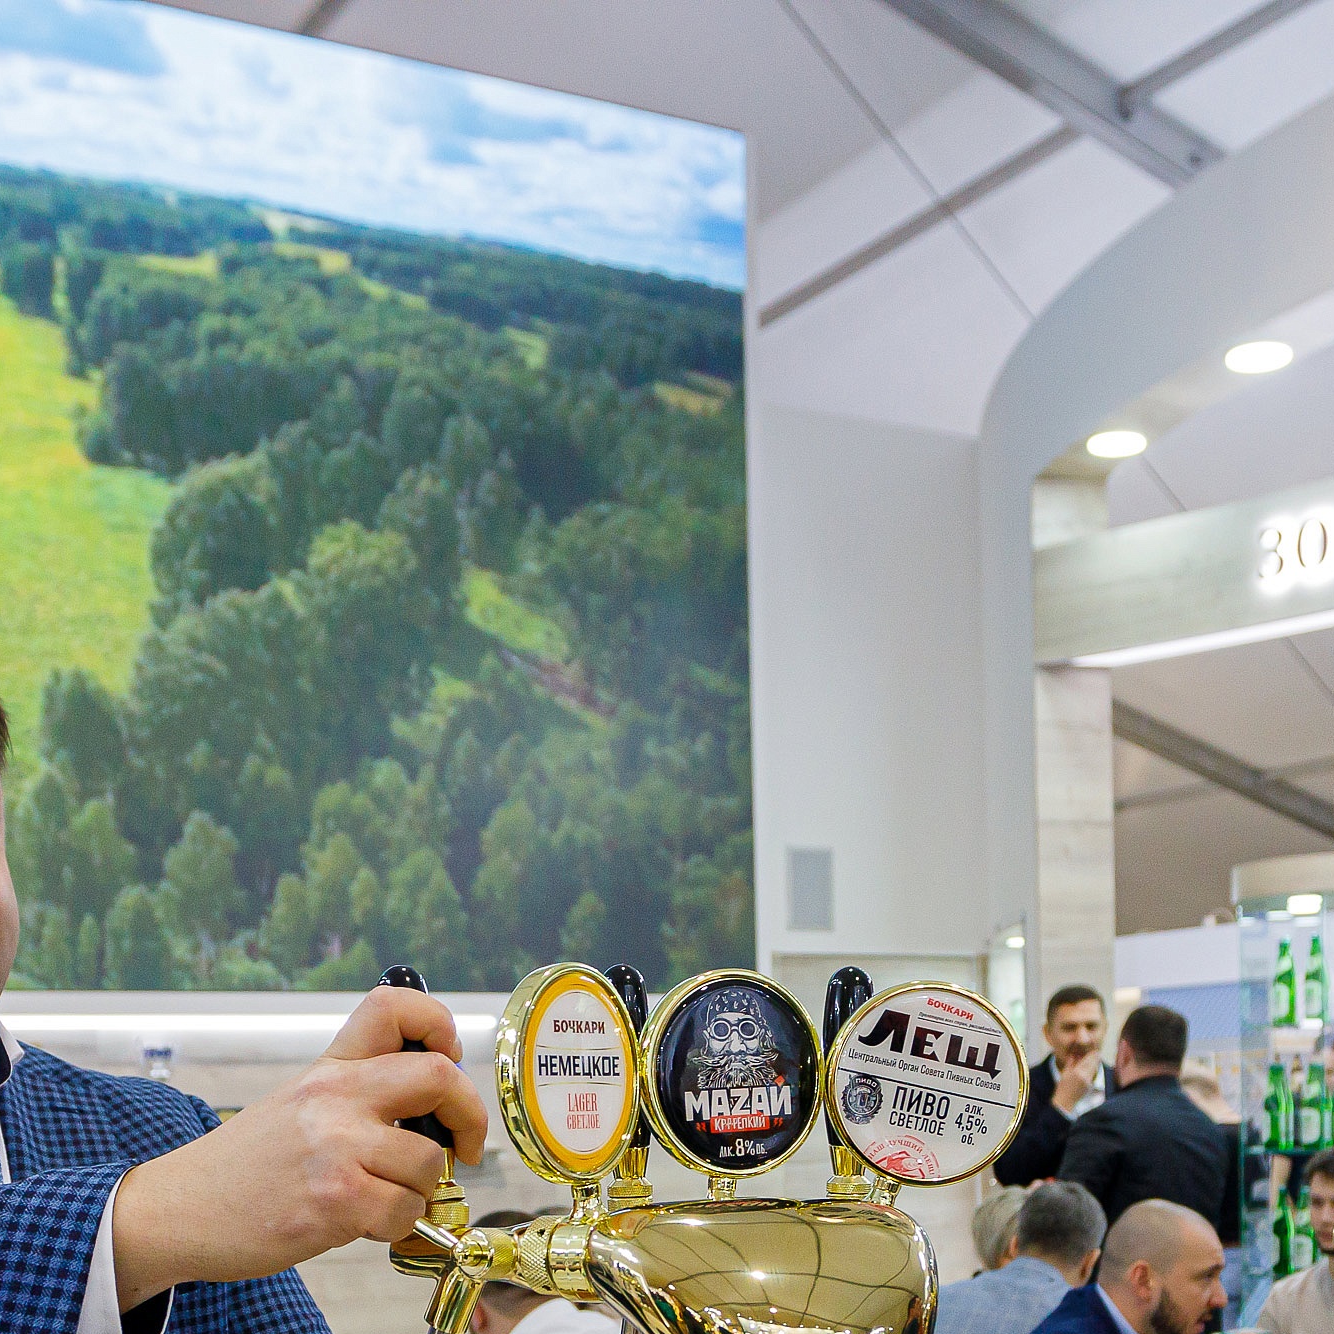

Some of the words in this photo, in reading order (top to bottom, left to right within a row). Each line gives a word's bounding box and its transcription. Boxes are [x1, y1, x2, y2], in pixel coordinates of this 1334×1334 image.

[926, 997, 974, 1021] БОЧКАРИ
[553, 1020, 605, 1034] БОЧКАРИ
[858, 1009, 1002, 1080] ЛЕЩ
[538, 1055, 620, 1079] НЕМЕЦКОЕ
[848, 1048, 897, 1068] Центральный
[898, 1059, 919, 1074] Орган
[920, 1064, 945, 1079] Совета
[946, 1070, 974, 1085] Пивных
[974, 1075, 1001, 1091] Союзов
[568, 1093, 598, 1112] LAGER
[892, 1085, 951, 1120] ПИВО
[964, 1103, 985, 1117] алк.
[567, 1114, 600, 1129] СВЕТЛОЕ
[889, 1111, 946, 1137] СВЕТЛОЕ
[954, 1112, 988, 1134] 4,5%
[960, 1133, 975, 1146] об.
